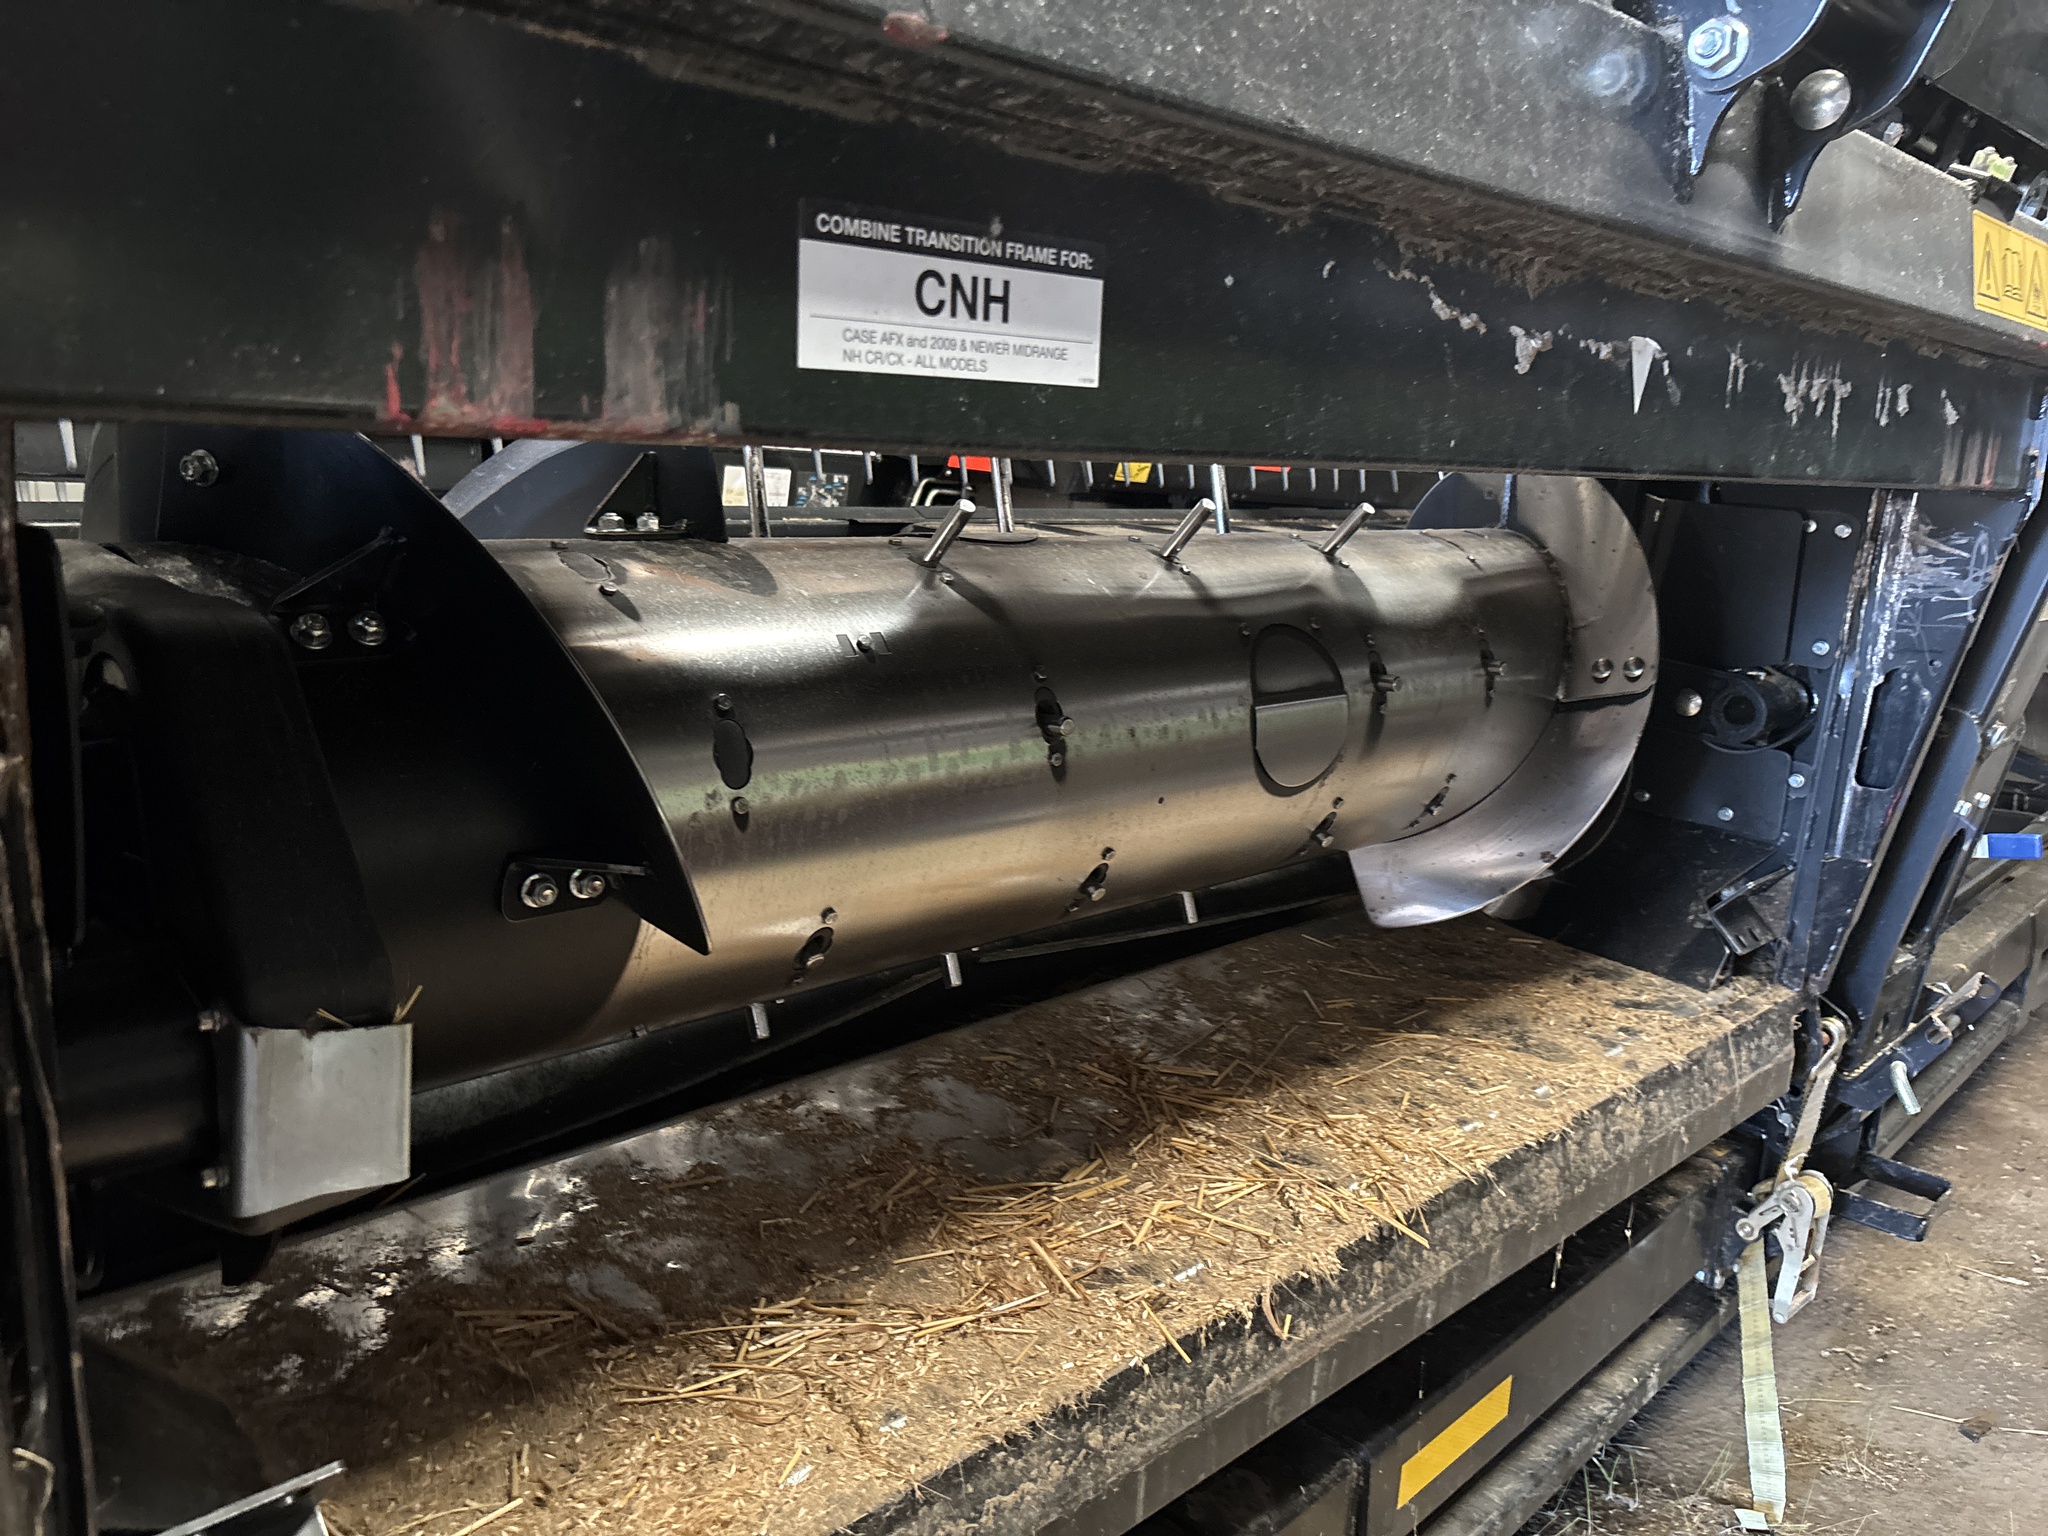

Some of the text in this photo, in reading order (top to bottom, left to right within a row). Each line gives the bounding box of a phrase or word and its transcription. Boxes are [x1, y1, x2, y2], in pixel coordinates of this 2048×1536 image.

[815, 212, 1093, 271] COMBINE TRANSITION FRAME FOR:
[915, 269, 1010, 324] CNH
[842, 328, 1068, 361] CASE AFX and 2009 & NEWER MIDRANGE
[842, 349, 862, 364] NH
[864, 350, 904, 366] CR/CX
[914, 354, 937, 369] ALL
[939, 356, 988, 373] MODELS
